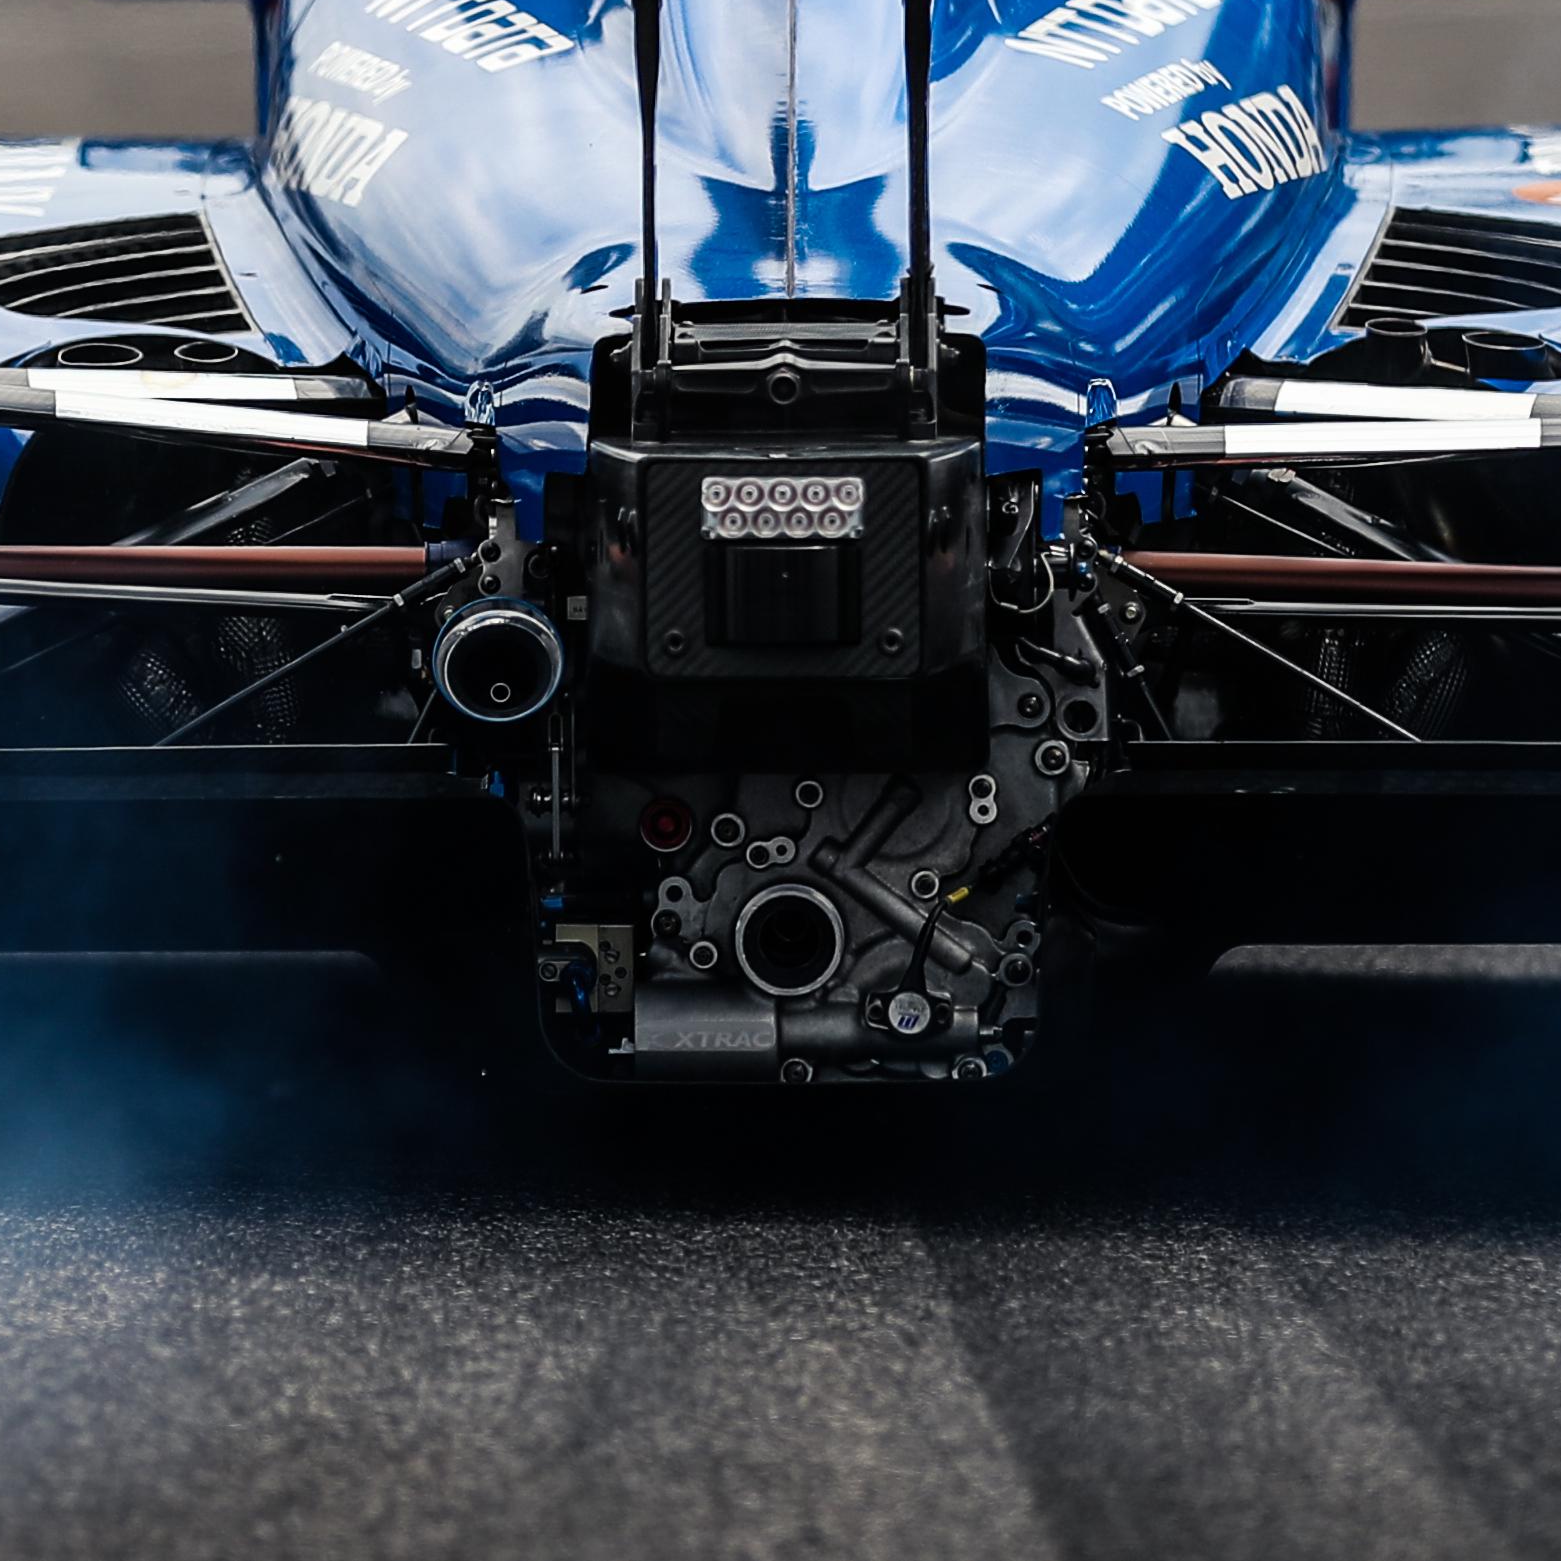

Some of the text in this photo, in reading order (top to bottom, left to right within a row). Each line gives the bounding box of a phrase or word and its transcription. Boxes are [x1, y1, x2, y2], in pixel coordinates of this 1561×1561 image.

[1099, 57, 1232, 121] POWERED by
[1161, 84, 1327, 199] HONDA
[673, 1031, 771, 1048] XTRAC
